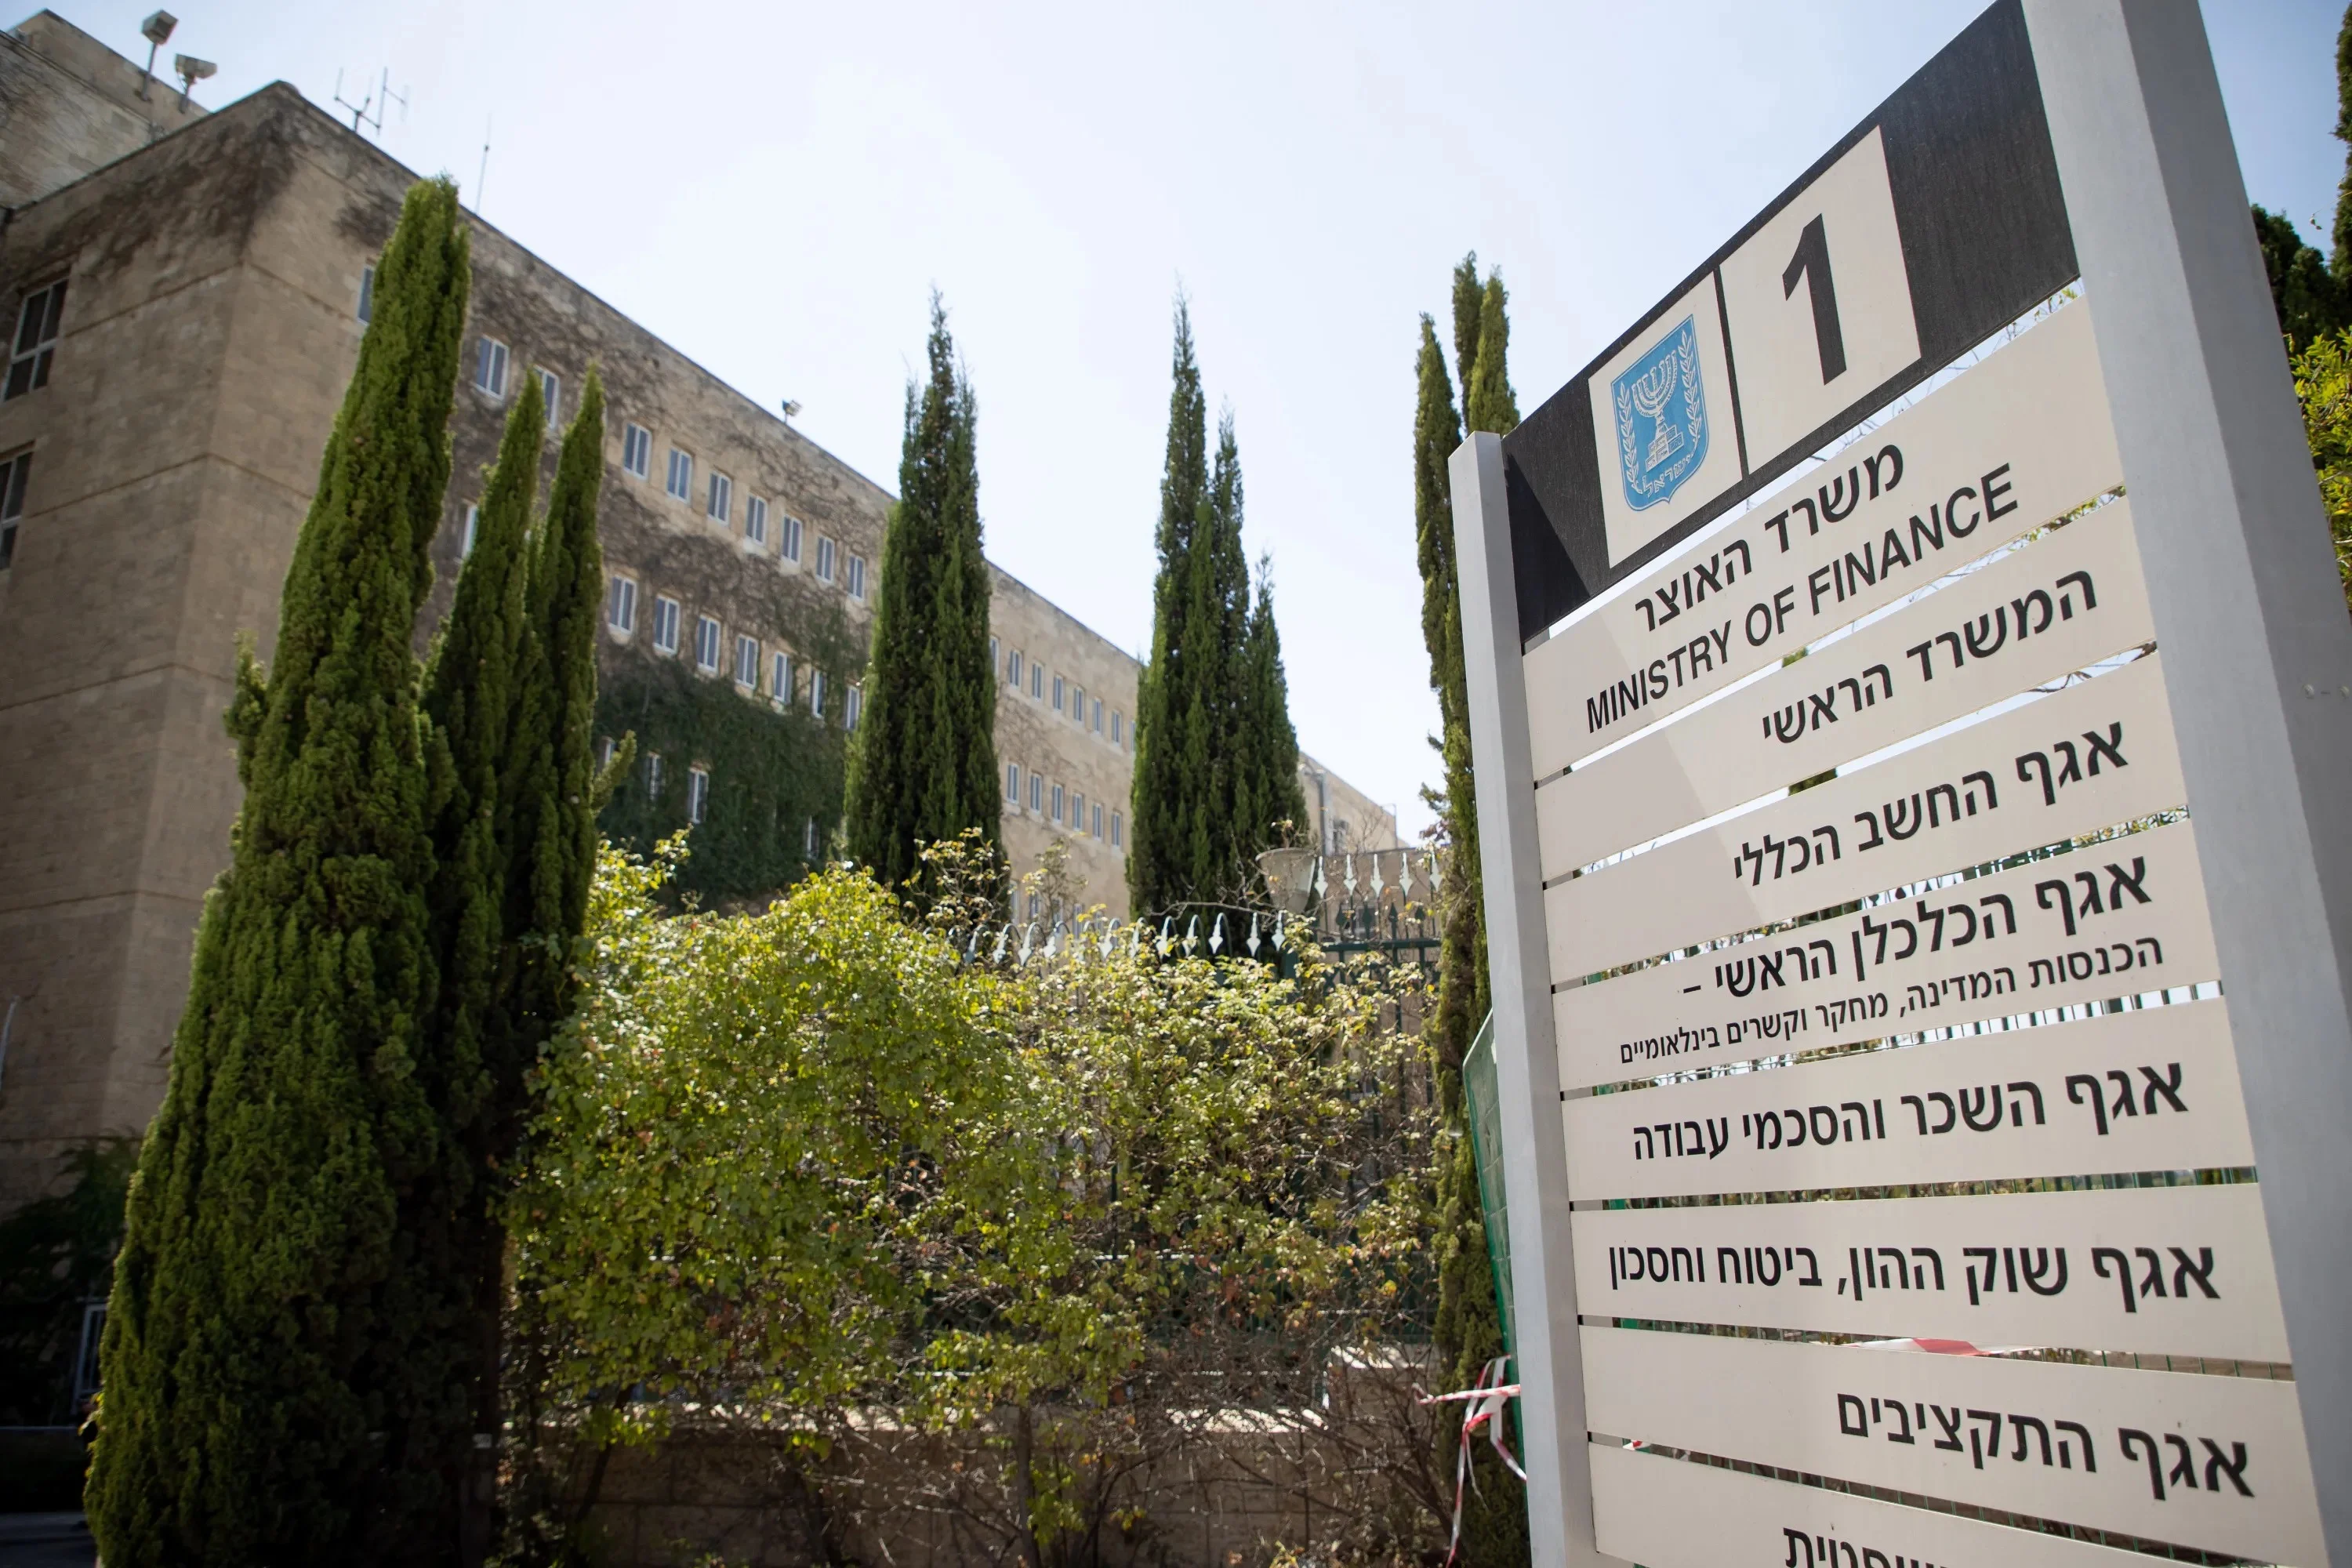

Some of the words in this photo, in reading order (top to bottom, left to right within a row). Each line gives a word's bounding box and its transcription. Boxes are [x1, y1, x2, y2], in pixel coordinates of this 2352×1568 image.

[1782, 213, 1846, 385] 1
[1642, 454, 1691, 499] ישראל
[1764, 445, 1904, 554] משרד
[1587, 619, 1732, 733] MINISTRY
[1746, 585, 1795, 647] OF
[1809, 463, 2018, 615] FINANCE
[1635, 539, 1752, 632] האוצר
[1906, 570, 2097, 682] המשרד
[1762, 663, 1893, 744] הראשי
[2015, 721, 2129, 807] אגף
[1854, 771, 1998, 852] החשב
[1733, 825, 1841, 887] הכללי
[2034, 855, 2152, 937] אגף
[1715, 939, 1837, 998] הראשי
[1851, 893, 2017, 982] הכלכלן
[2027, 937, 2164, 989] הכנסות
[1815, 993, 1889, 1033] מחקר
[1897, 967, 2016, 1019] המדינה,
[1620, 1022, 1722, 1064] בינלאומיים
[1725, 1009, 1811, 1045] וקשרים
[1742, 1098, 1886, 1150] והסכמי
[1900, 1081, 2046, 1136] השכר
[2065, 1062, 2189, 1136] אגף
[1633, 1116, 1730, 1160] עבודה
[1609, 1247, 1705, 1290] וחסכון
[1716, 1247, 1823, 1287] ביטוח
[1836, 1247, 1946, 1301] ההון,
[1962, 1247, 2068, 1306] שוק
[2091, 1247, 2221, 1314] אגף
[1837, 1393, 2097, 1473] התקציבים
[2118, 1427, 2256, 1503] אגף
